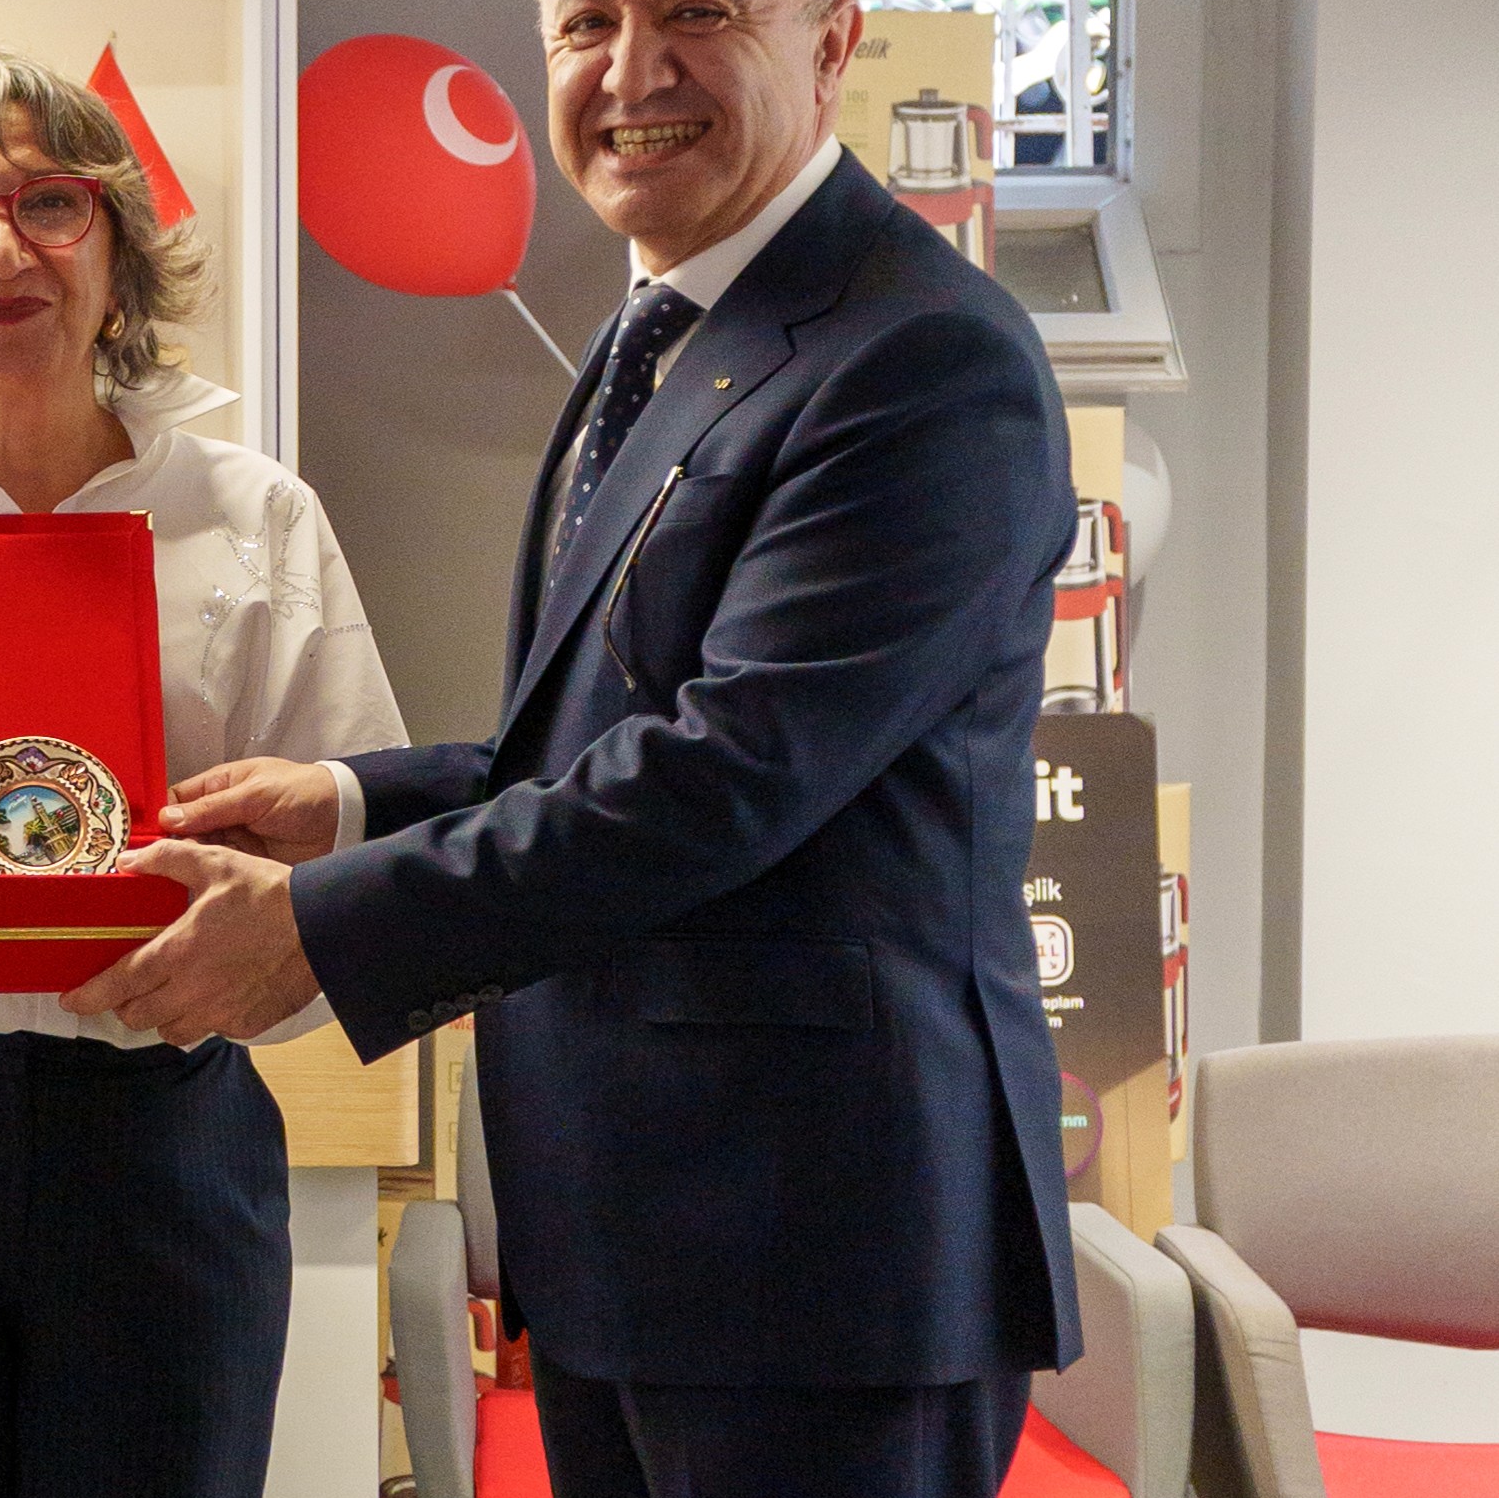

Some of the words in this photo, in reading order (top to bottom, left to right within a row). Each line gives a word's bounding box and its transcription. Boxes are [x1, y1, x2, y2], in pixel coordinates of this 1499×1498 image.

[854, 38, 891, 59] elik
[1035, 759, 1085, 823] it
[1022, 876, 1063, 908] şlik
[1042, 994, 1084, 1013] oplam
